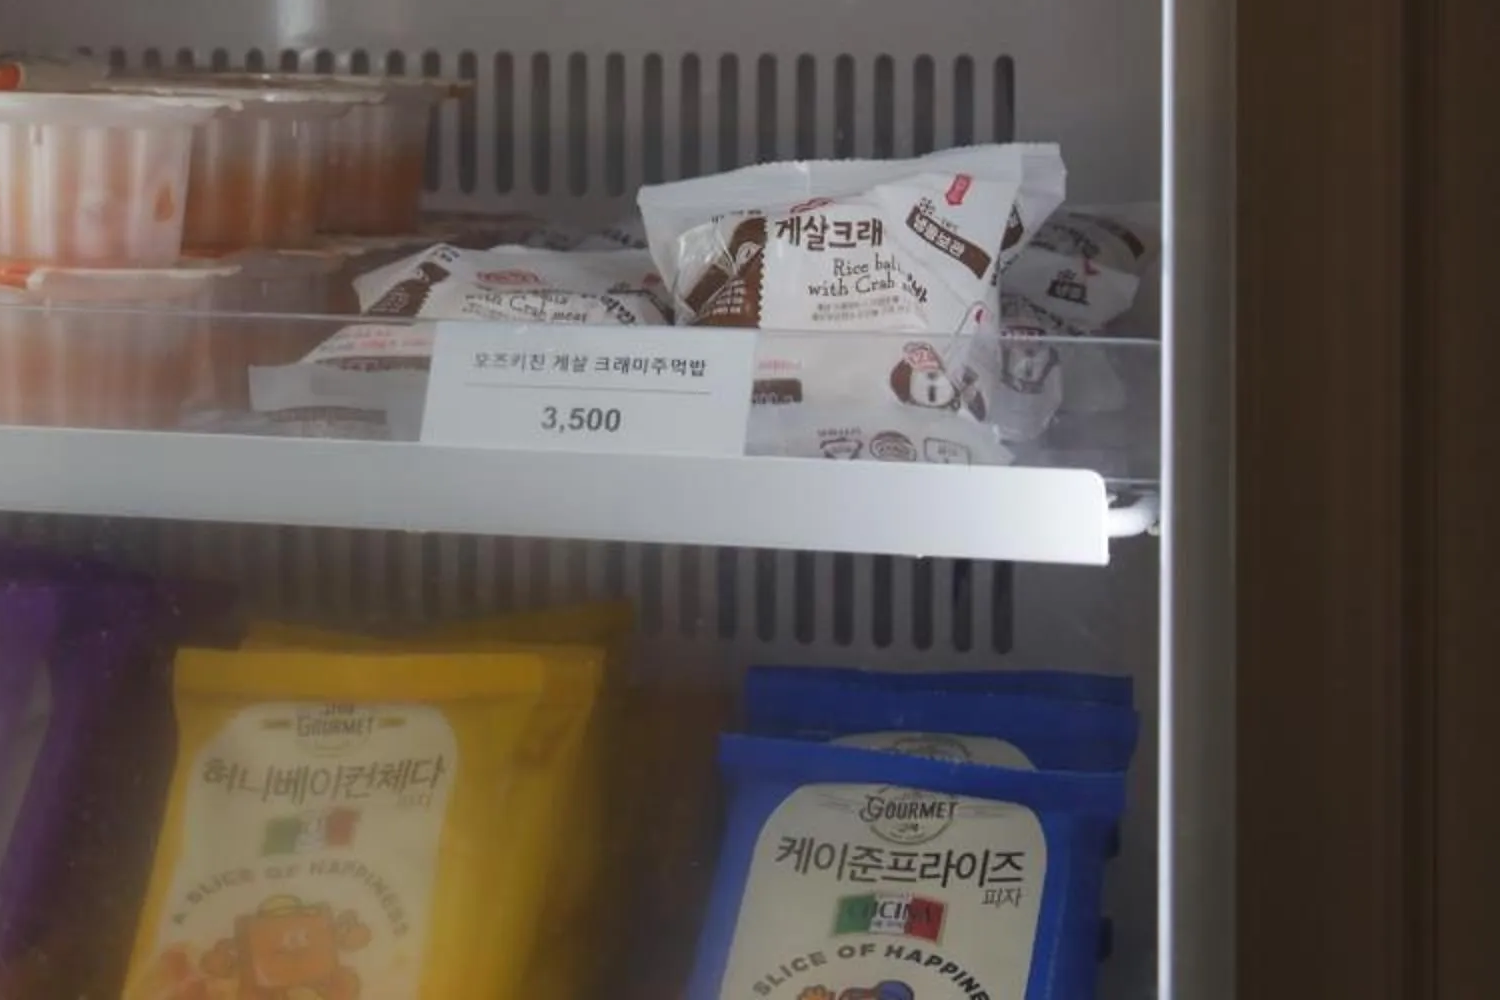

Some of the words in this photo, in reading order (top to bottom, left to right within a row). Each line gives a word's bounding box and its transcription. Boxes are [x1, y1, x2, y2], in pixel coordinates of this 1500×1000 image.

[833, 256, 870, 277] Rice
[808, 277, 849, 297] with
[854, 272, 896, 293] Crab
[553, 353, 589, 374] 게살
[595, 356, 707, 378] 크래미주먹밥
[541, 406, 622, 433] 3,500
[201, 753, 448, 806] 허니베이컨체다
[859, 795, 960, 823] GOURMET
[775, 835, 1026, 888] 케이준프라이즈
[981, 887, 1022, 909] 피자
[751, 950, 830, 997] SLICE
[836, 943, 879, 960] OF
